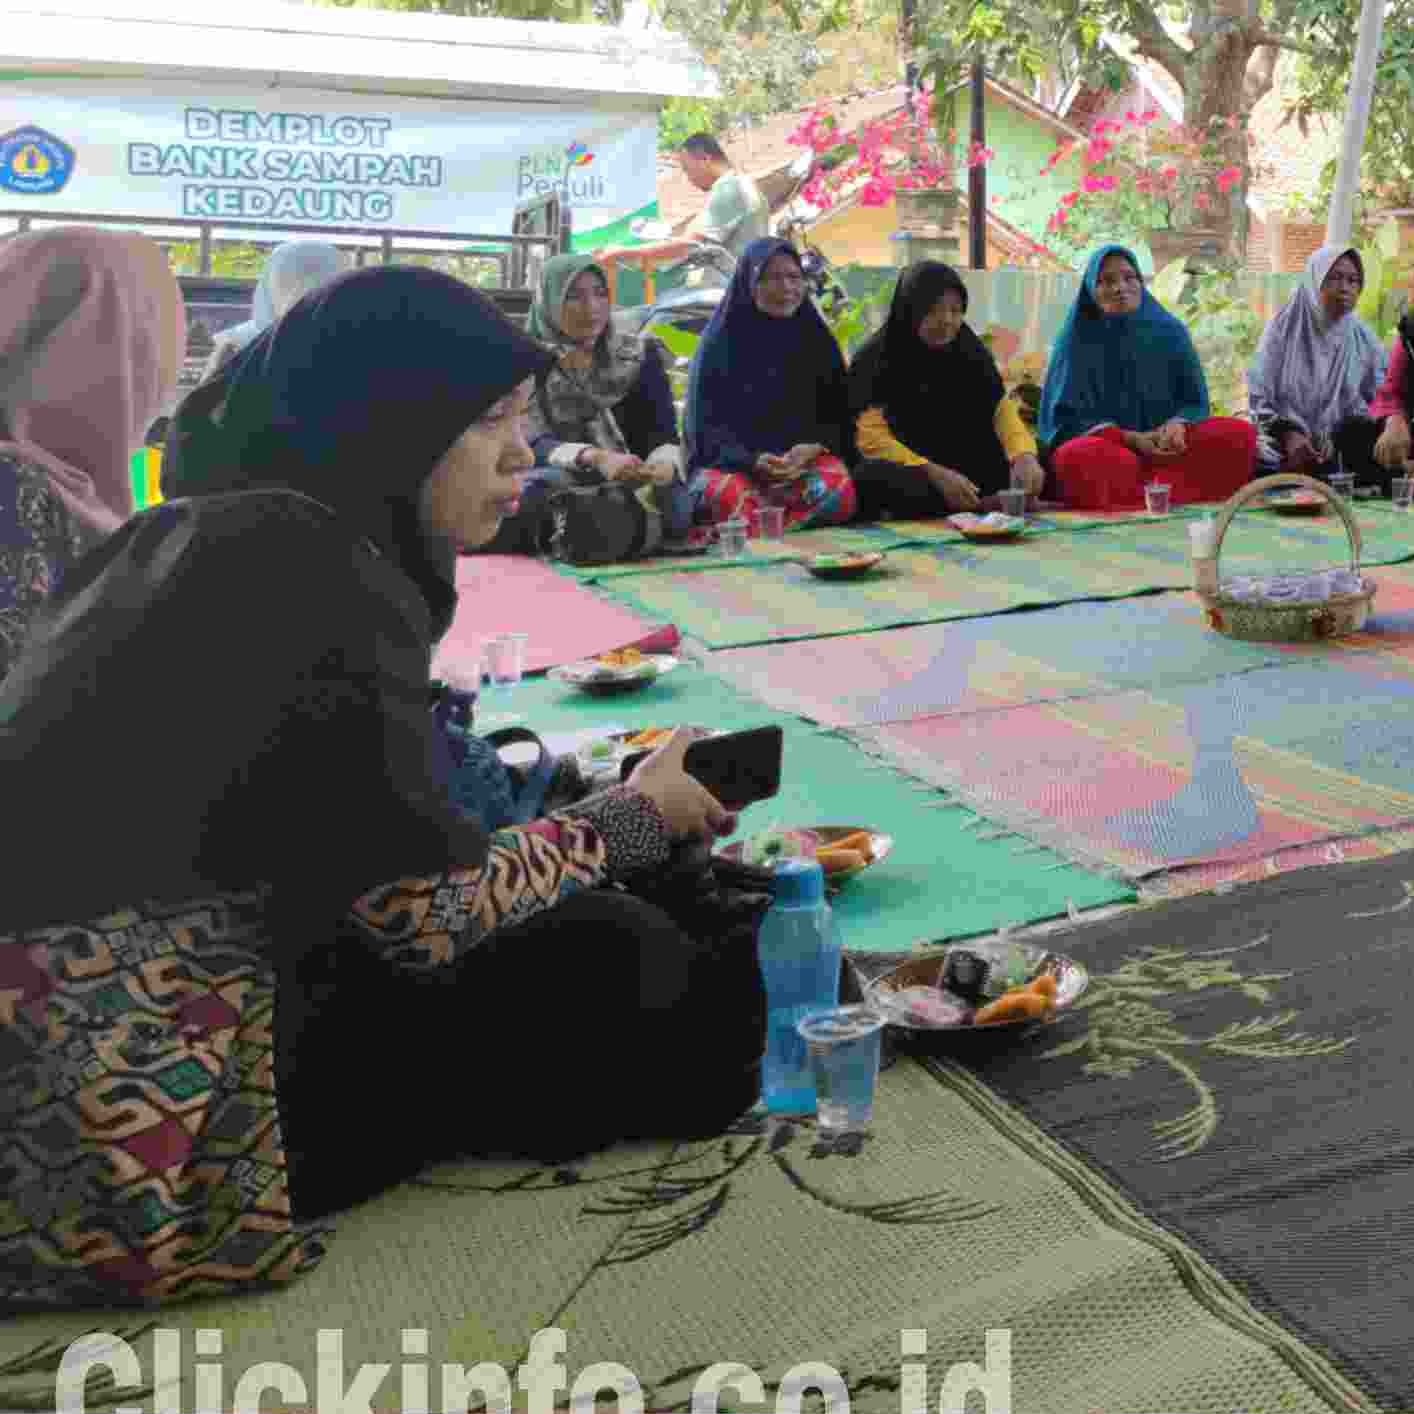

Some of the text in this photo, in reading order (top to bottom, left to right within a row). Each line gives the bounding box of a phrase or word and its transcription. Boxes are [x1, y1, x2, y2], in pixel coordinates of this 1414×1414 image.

[184, 107, 392, 147] DEMPLOT
[127, 142, 443, 187] BANK SAMPAH
[516, 153, 562, 176] PLN
[183, 183, 393, 221] KEDAUNG
